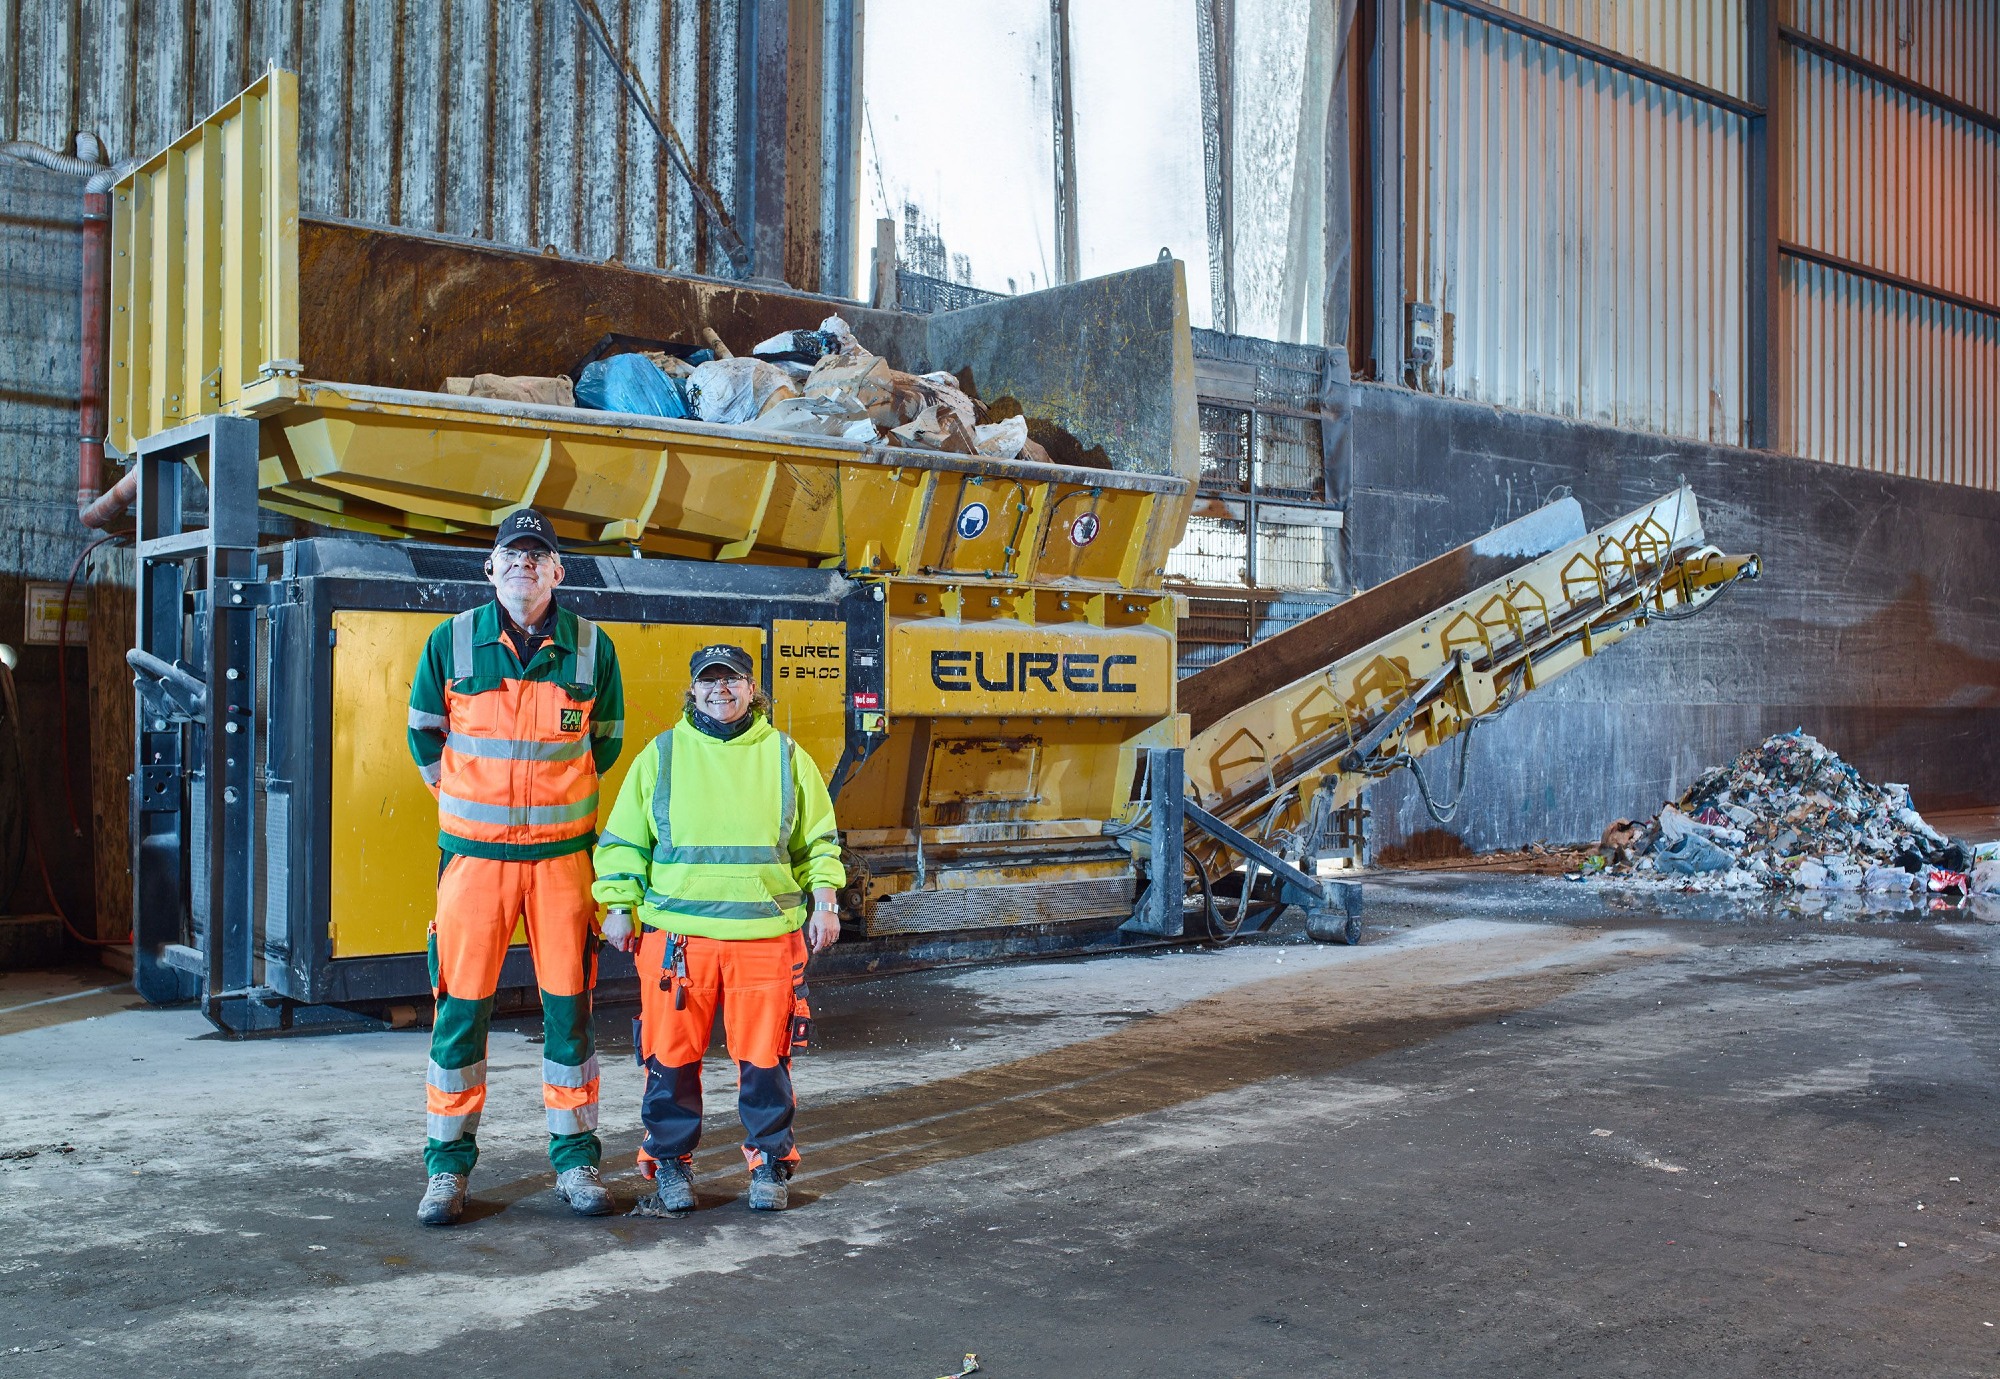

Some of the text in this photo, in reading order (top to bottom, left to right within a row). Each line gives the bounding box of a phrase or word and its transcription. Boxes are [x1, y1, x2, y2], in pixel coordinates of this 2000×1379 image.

[516, 516, 540, 526] ZAK
[706, 647, 730, 656] ZAK
[780, 646, 840, 658] EUREC
[780, 667, 840, 678] S 24.00
[930, 650, 1136, 692] EUREC
[855, 694, 866, 704] Not
